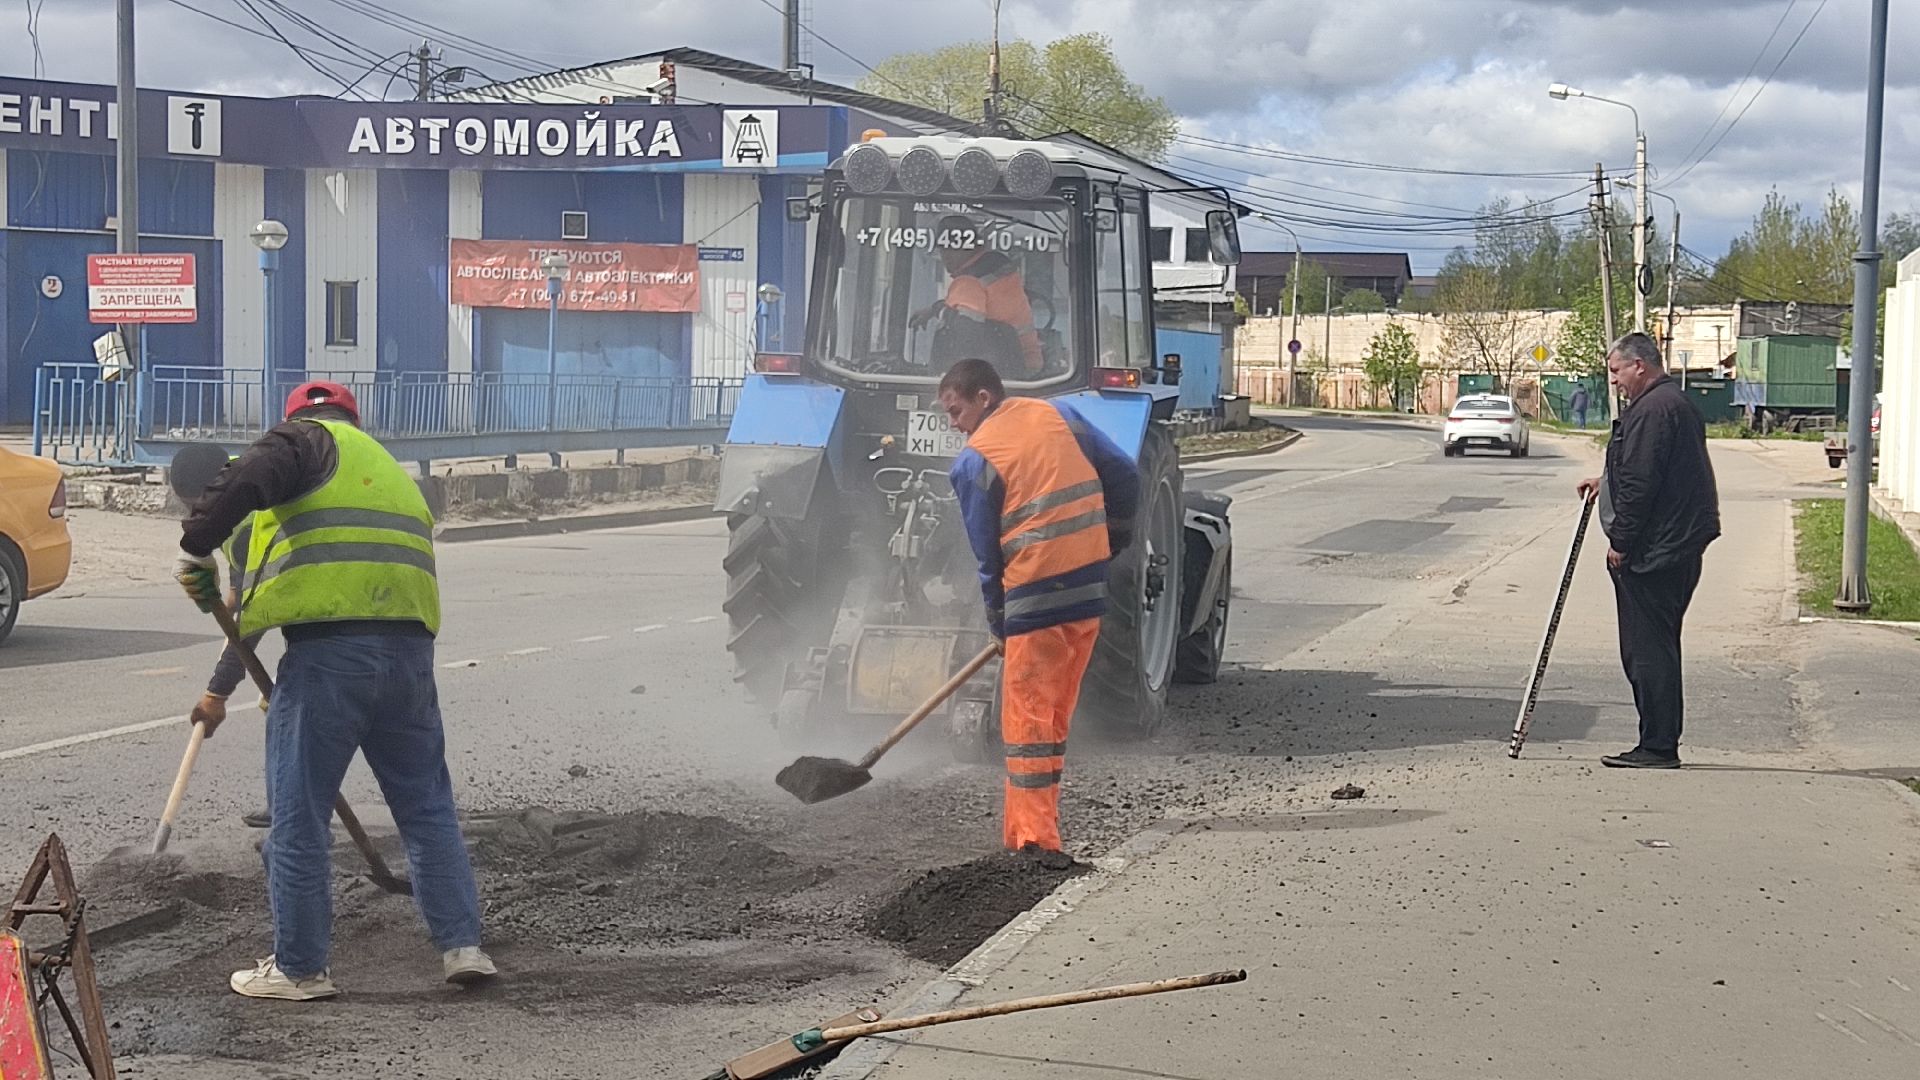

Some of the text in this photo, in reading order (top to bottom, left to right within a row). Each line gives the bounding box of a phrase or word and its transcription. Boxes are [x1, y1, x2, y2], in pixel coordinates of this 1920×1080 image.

[347, 110, 682, 158] АВТОМОЙКА
[95, 257, 184, 265] ЧАСТНАЯ ТЕРРИТОРИЯ
[731, 250, 743, 259] 45
[457, 265, 550, 281] АВТОСЛЕСАР
[575, 270, 694, 285] АВТОЭЛЕКТРИКИ
[47, 278, 57, 292] 2
[100, 295, 182, 307] ЗАПРЕЩЕНА
[511, 288, 527, 302] +7
